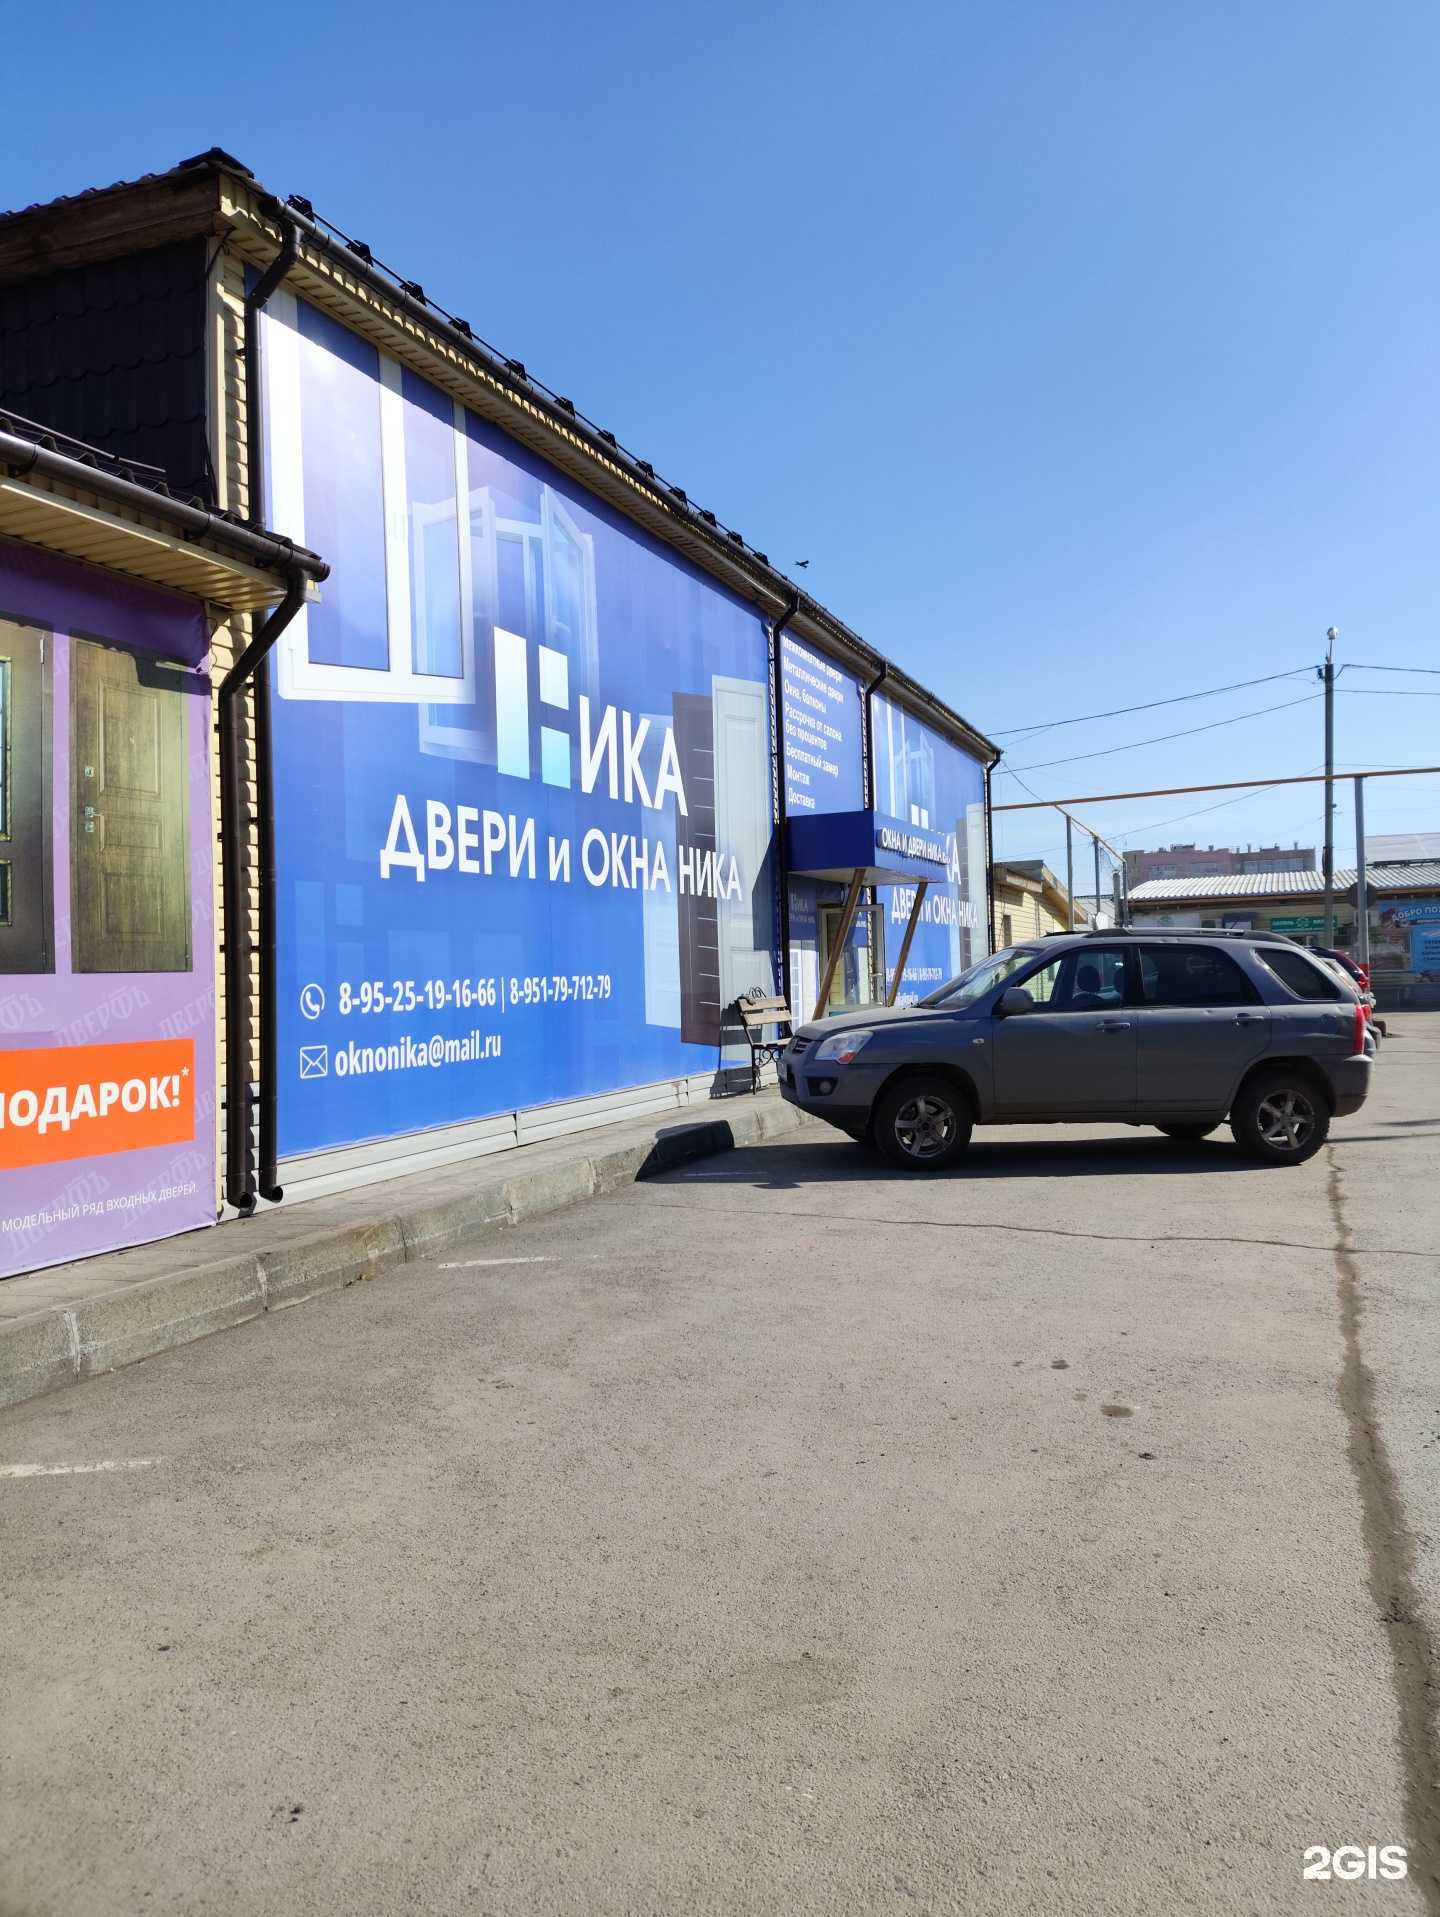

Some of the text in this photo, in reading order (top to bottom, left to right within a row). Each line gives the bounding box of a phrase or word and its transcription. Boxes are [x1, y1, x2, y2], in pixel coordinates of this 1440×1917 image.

[785, 701, 815, 728] Рассрочка
[786, 742, 822, 769] Бесплатный
[788, 787, 815, 809] Доставка
[379, 794, 743, 901] ДВЕРИ и ОКНА НИКА
[881, 827, 901, 851] ОКНА
[902, 833, 907, 853] И
[907, 835, 927, 858] ДВЕРИ
[932, 895, 958, 926] ОКНА
[339, 979, 497, 1015] 8-95-25-19-16-66
[510, 975, 611, 1005] 8-951-79-712-79
[335, 1030, 502, 1076] oknonika@mail.ru
[0, 1066, 189, 1134] ОДАРОК!
[2, 1201, 80, 1233] МОДЕЛЬНЫЙ
[82, 1200, 105, 1216] РЯД
[106, 1191, 157, 1213] ВХОДНЫХ
